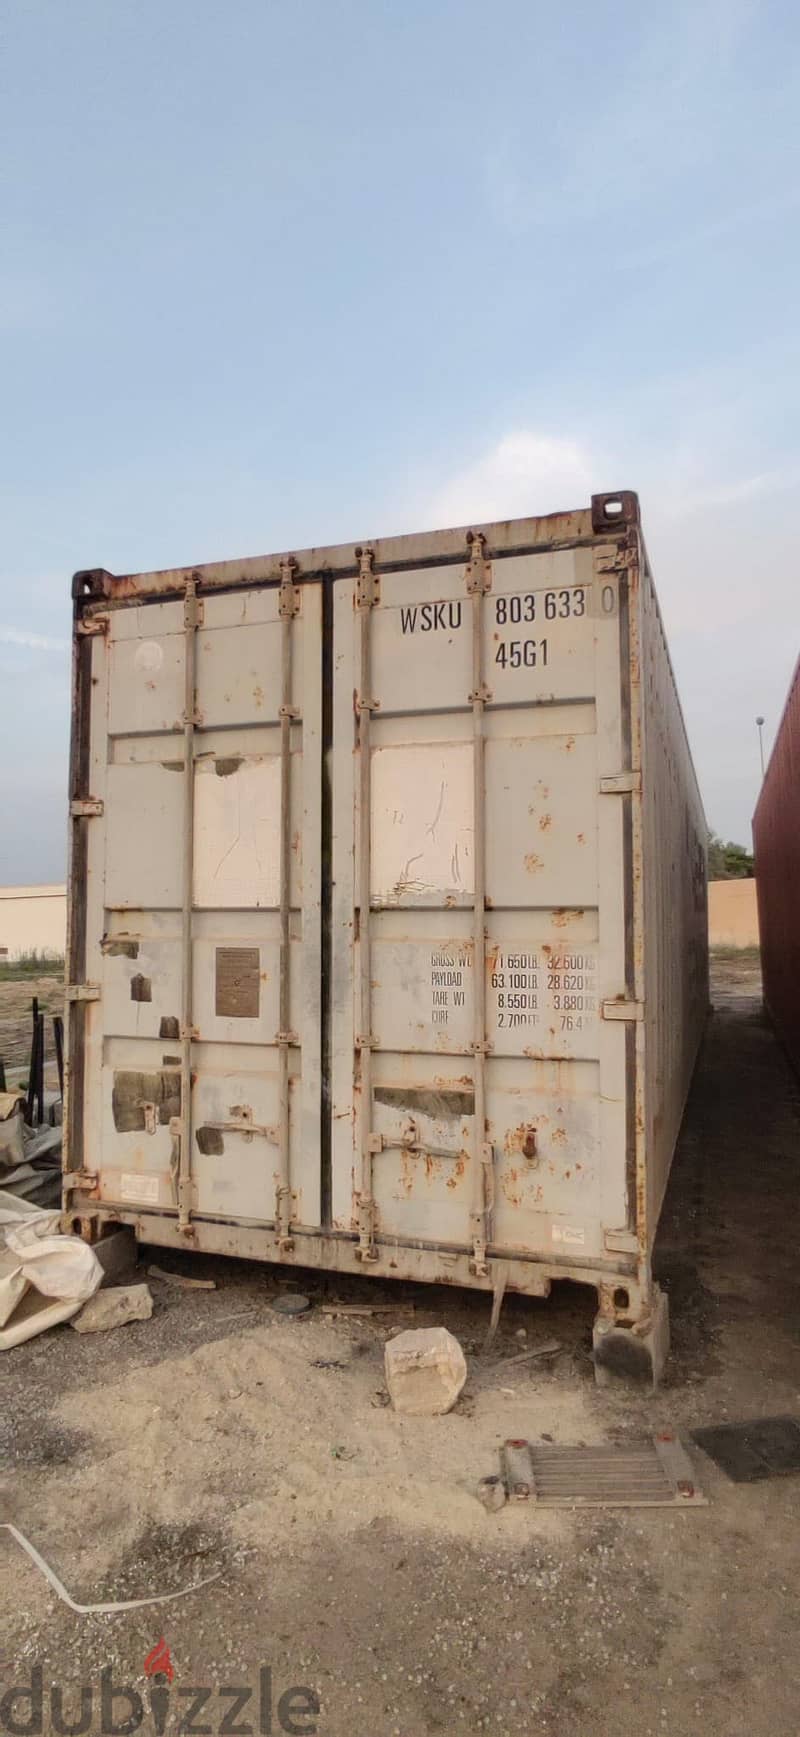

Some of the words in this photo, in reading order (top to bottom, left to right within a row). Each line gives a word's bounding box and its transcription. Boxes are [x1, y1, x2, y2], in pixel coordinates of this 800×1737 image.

[401, 602, 462, 634] WSKU
[496, 594, 536, 625] 803
[544, 588, 585, 620] 633
[601, 585, 614, 613] 0
[495, 638, 548, 669] 45G1
[431, 971, 462, 987] PAYLOAD
